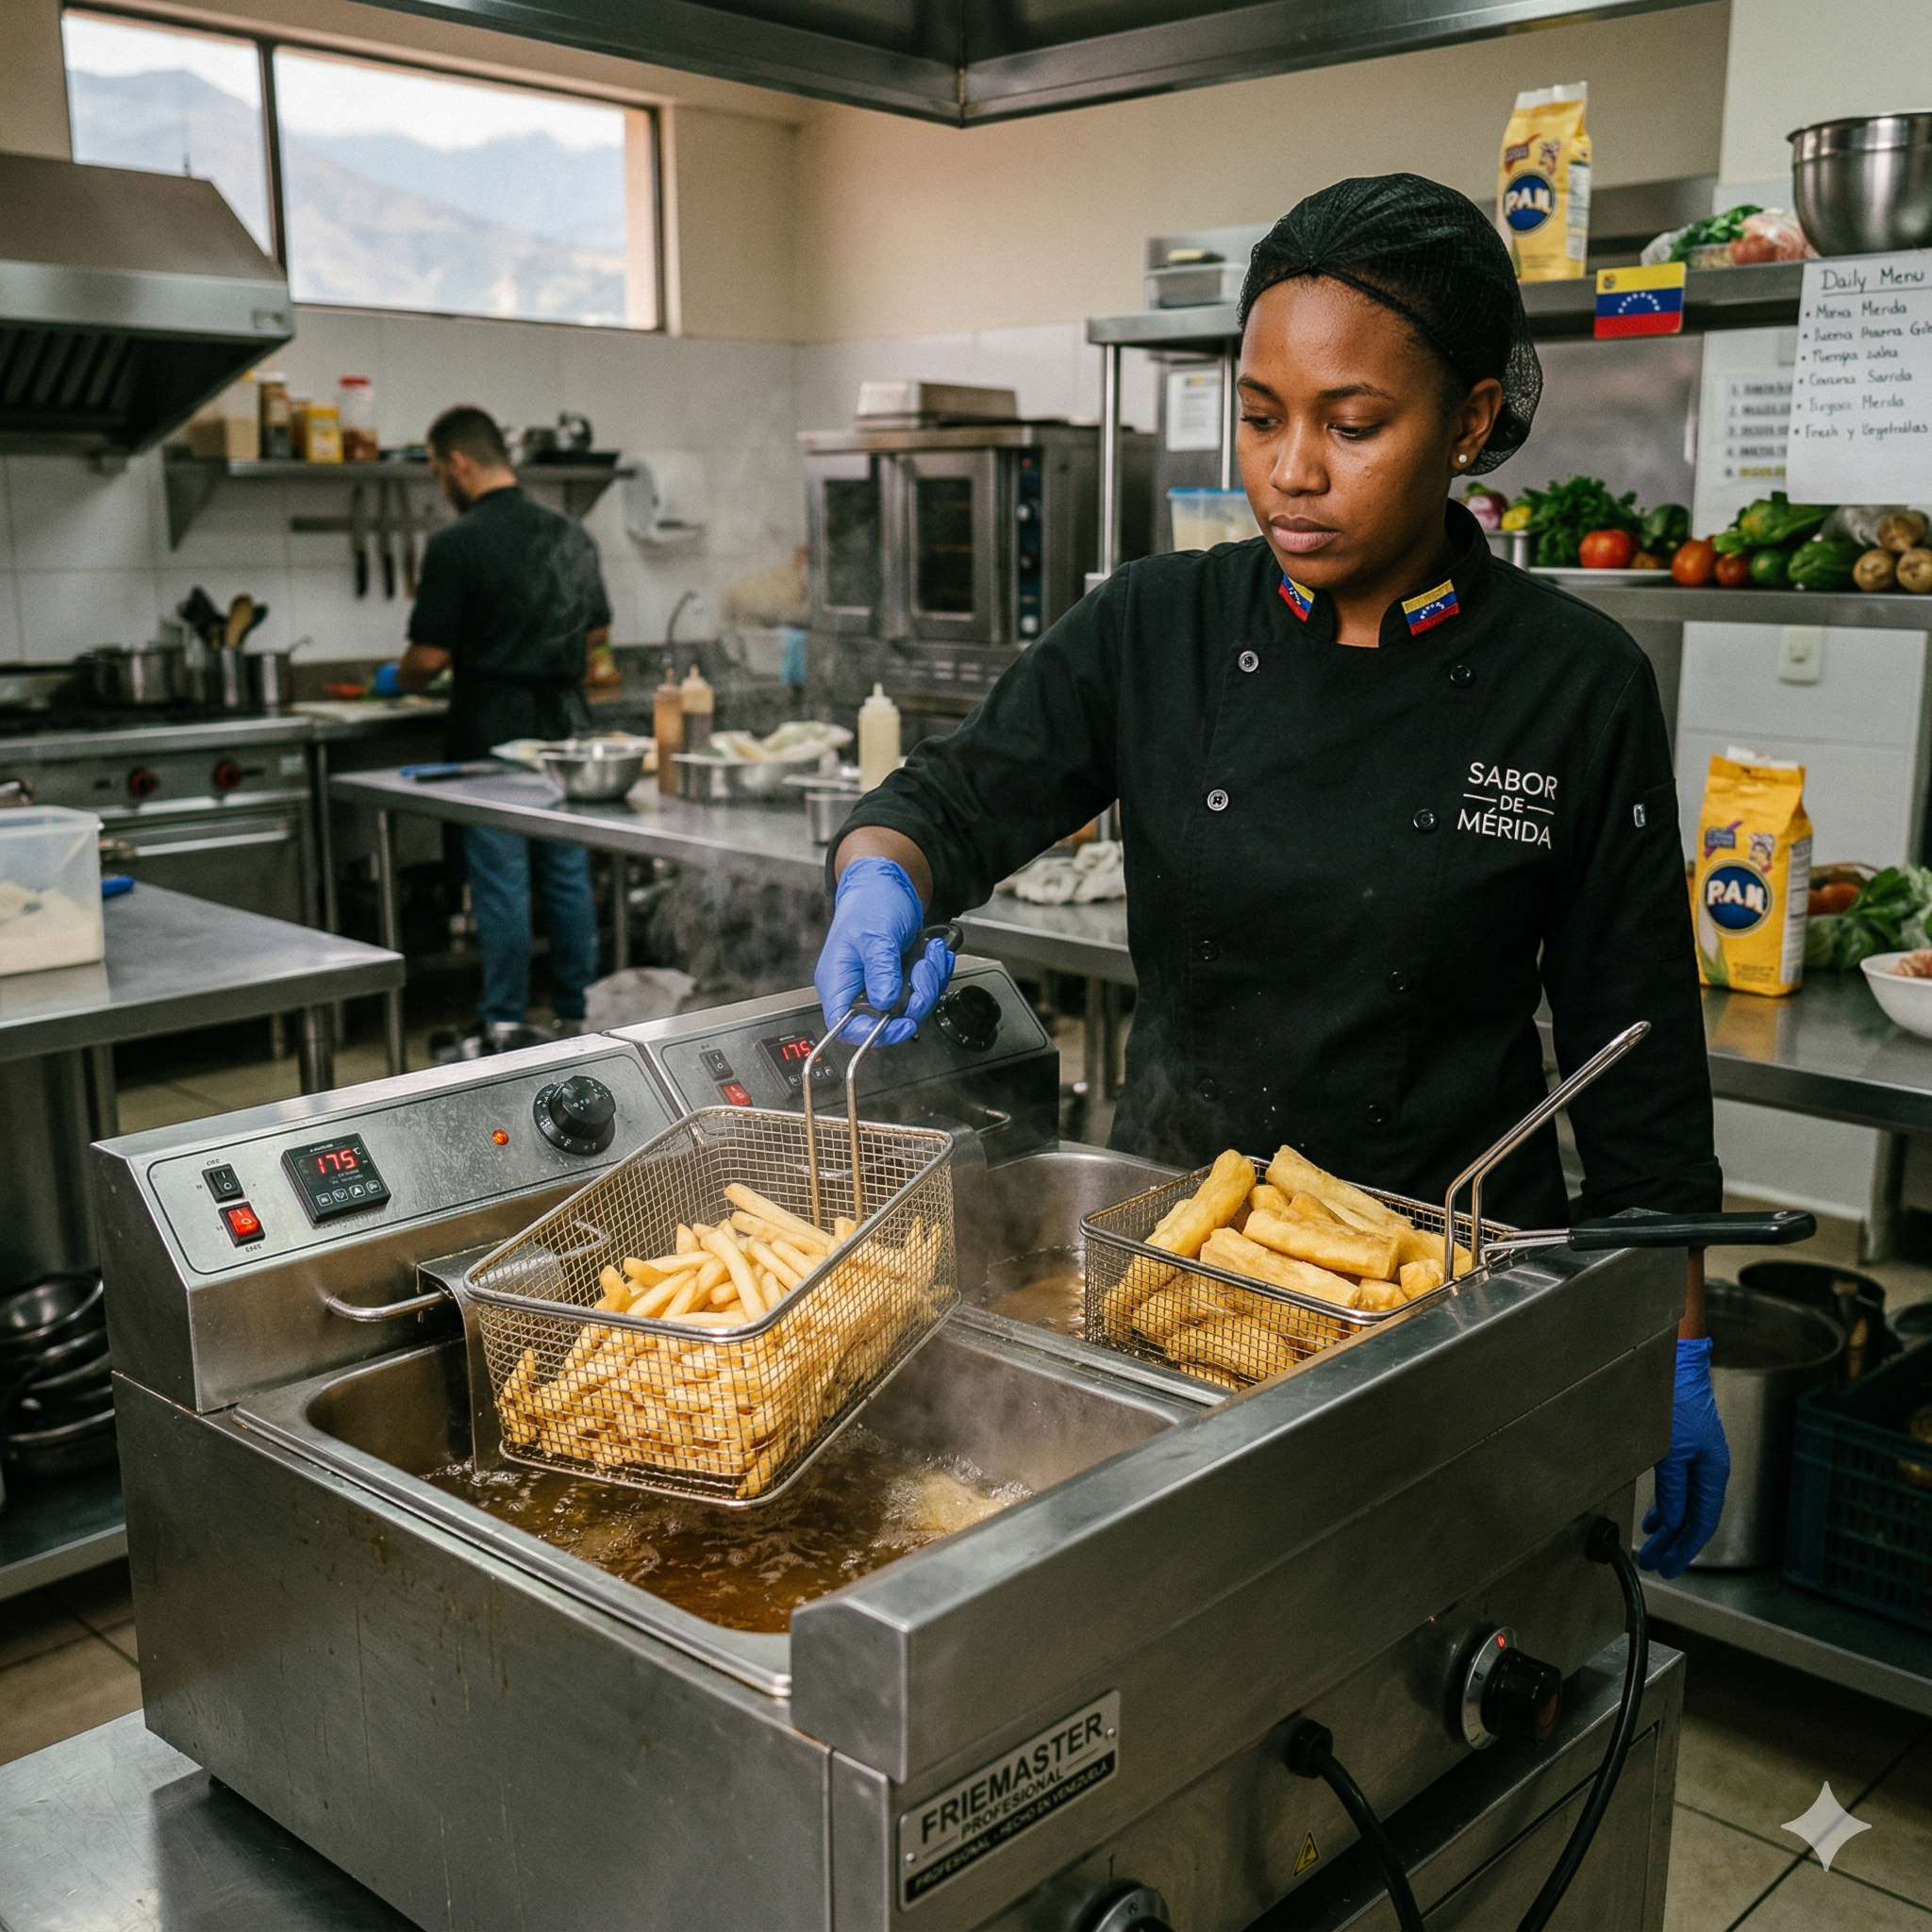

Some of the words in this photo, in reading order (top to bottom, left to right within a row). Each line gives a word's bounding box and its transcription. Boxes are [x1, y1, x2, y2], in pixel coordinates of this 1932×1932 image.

[1822, 268, 1867, 293] Daily
[1880, 266, 1924, 285] Menu
[1467, 762, 1558, 800] SABOR
[1500, 795, 1524, 813] DE
[1457, 807, 1552, 850] MÉRIDA
[781, 1040, 811, 1061] 175
[317, 1148, 358, 1174] 175
[921, 1711, 1103, 1844] FRIEMASTER
[960, 1767, 1064, 1840] PROFESIONAL
